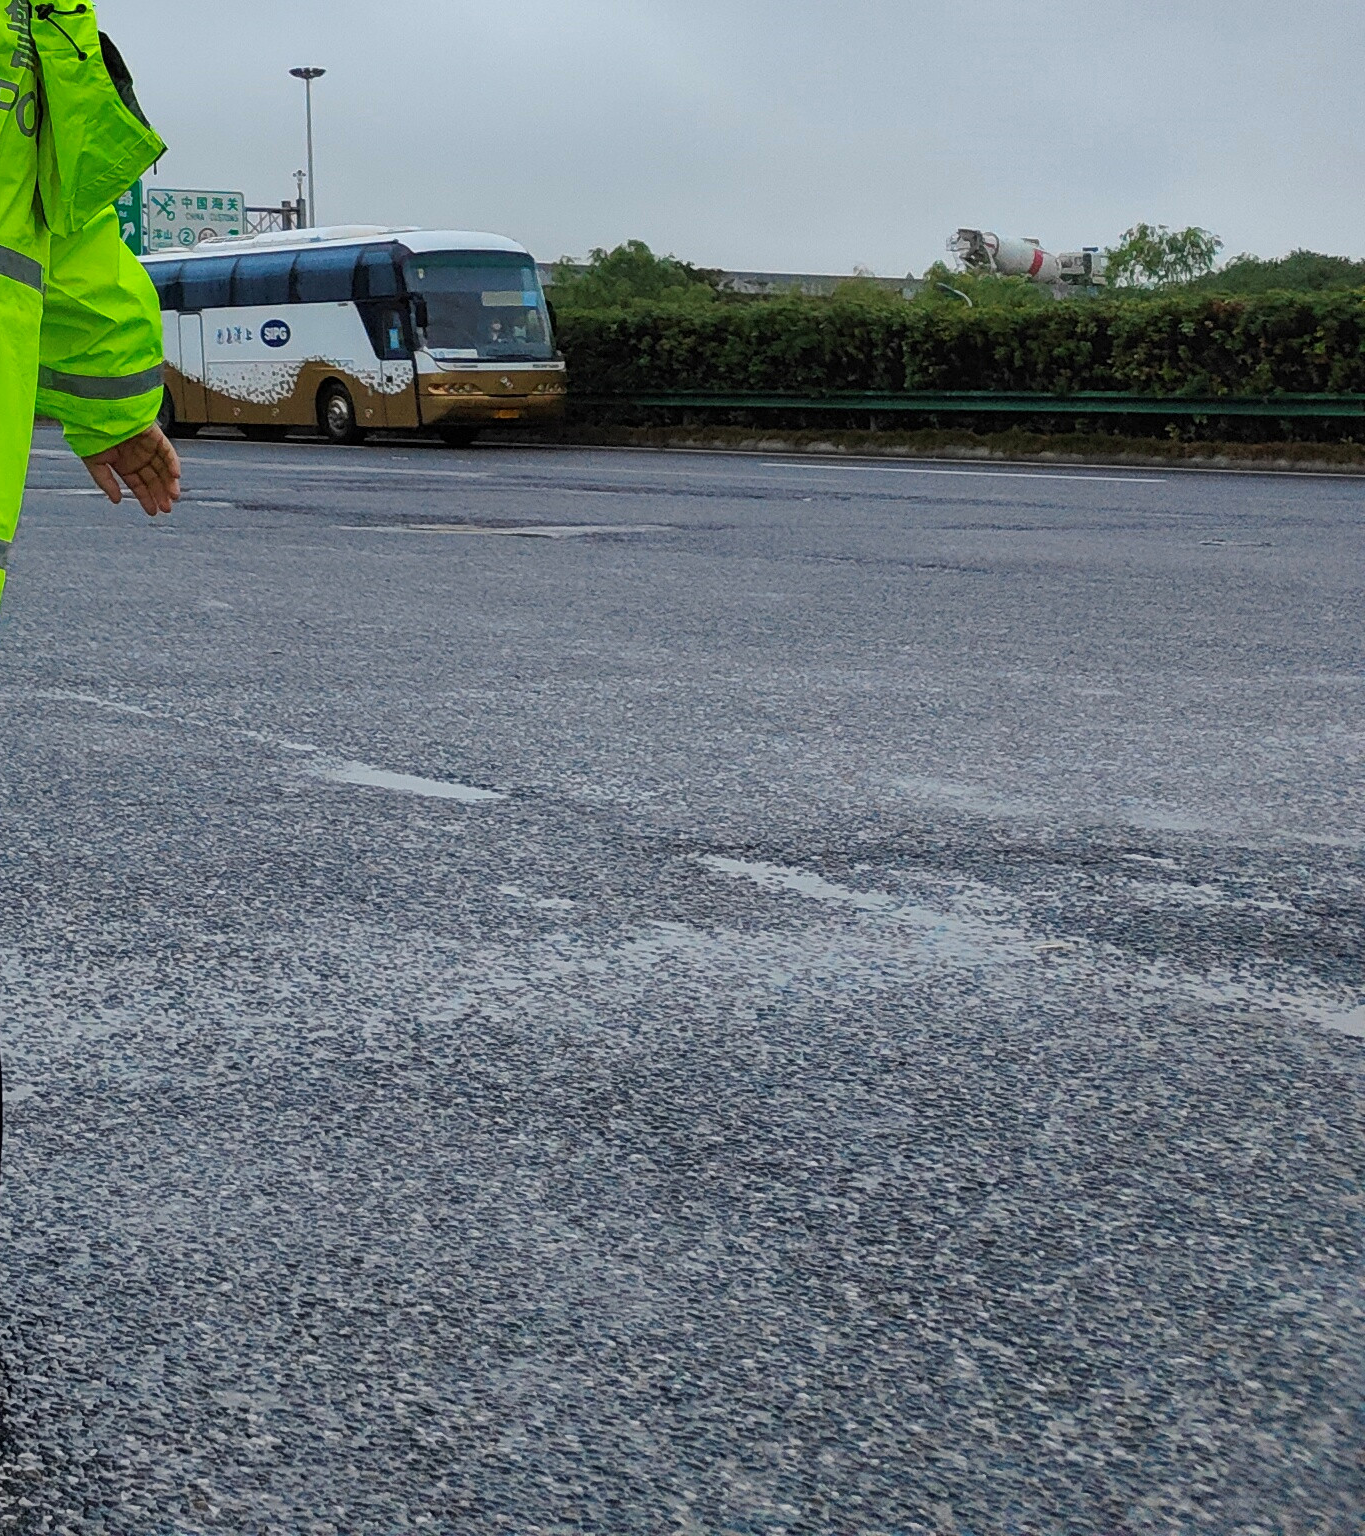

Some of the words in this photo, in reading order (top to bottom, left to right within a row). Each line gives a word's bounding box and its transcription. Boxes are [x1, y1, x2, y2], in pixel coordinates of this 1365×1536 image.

[181, 196, 239, 211] 中国海关
[264, 326, 288, 340] SIPG
